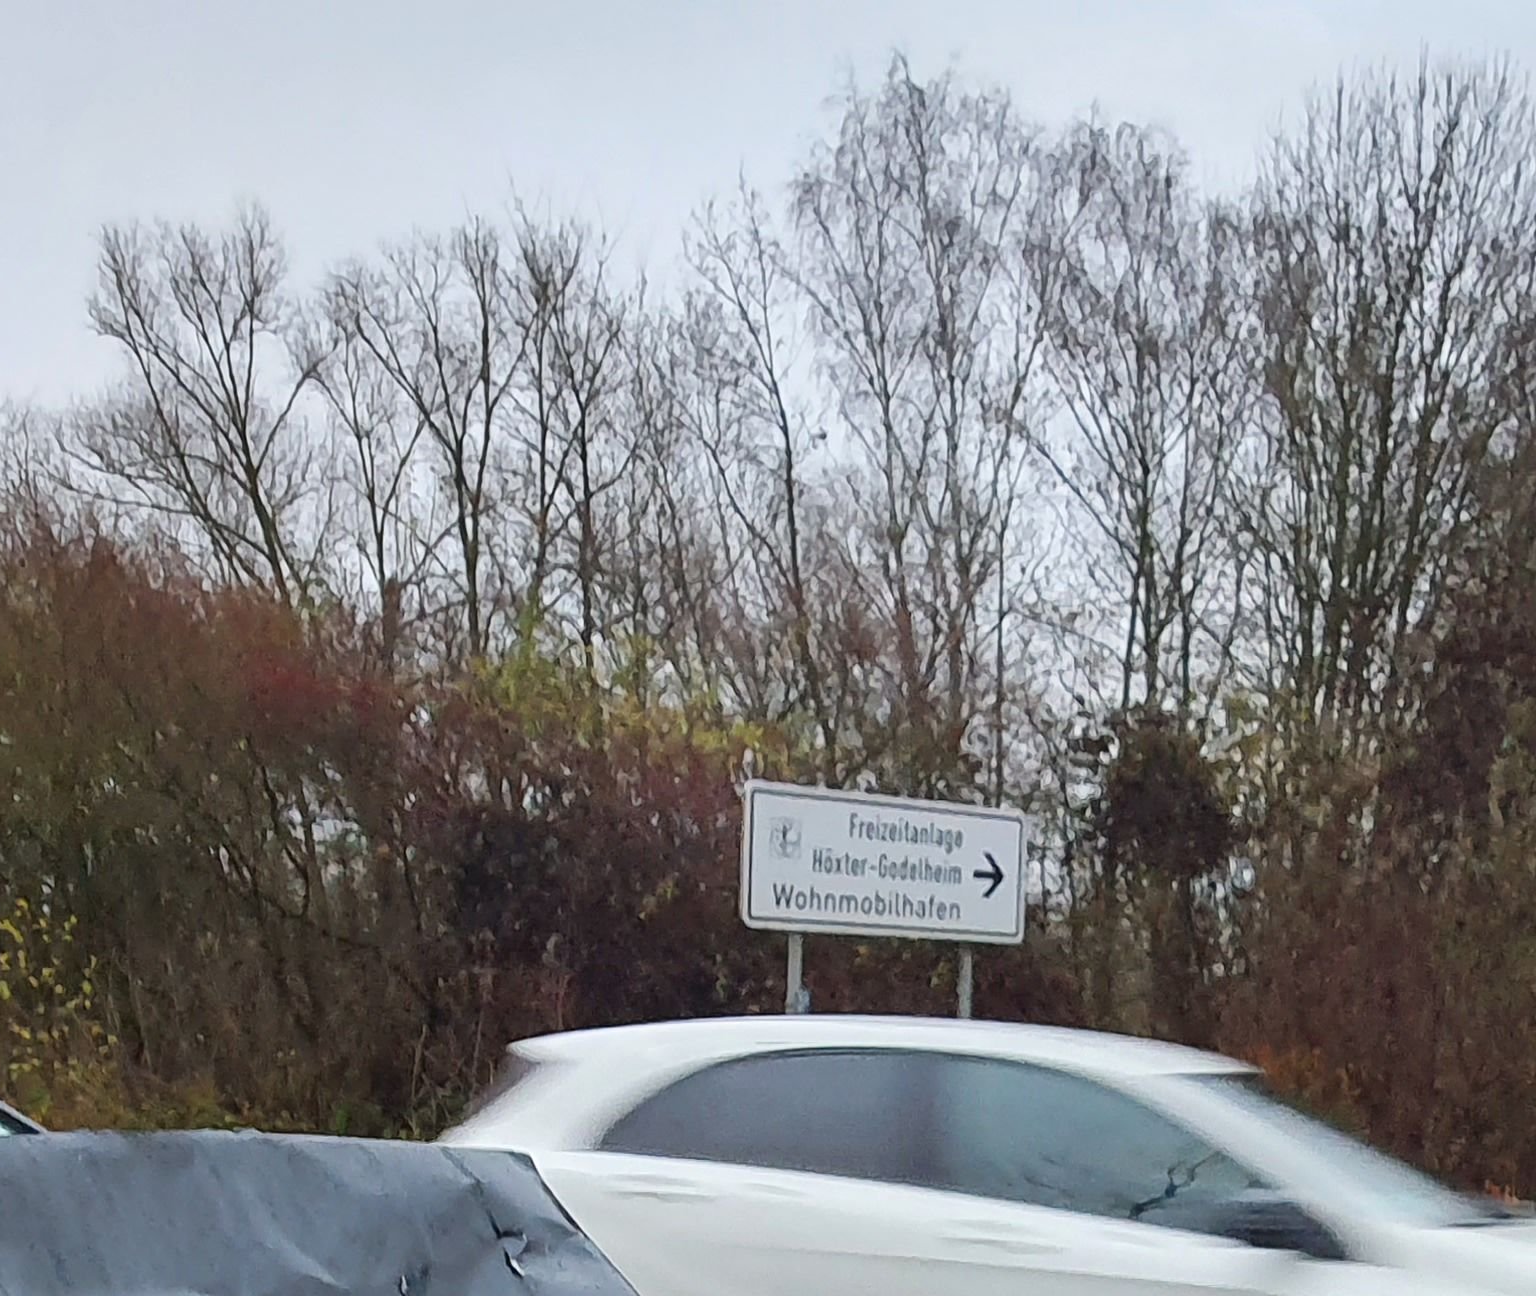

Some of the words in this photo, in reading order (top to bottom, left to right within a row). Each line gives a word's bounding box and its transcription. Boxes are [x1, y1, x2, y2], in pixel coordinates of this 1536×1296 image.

[849, 812, 963, 854] Freizeitanlage
[812, 848, 962, 884] Höxter-Godelheim
[773, 883, 961, 920] Wohnmobilhafen
